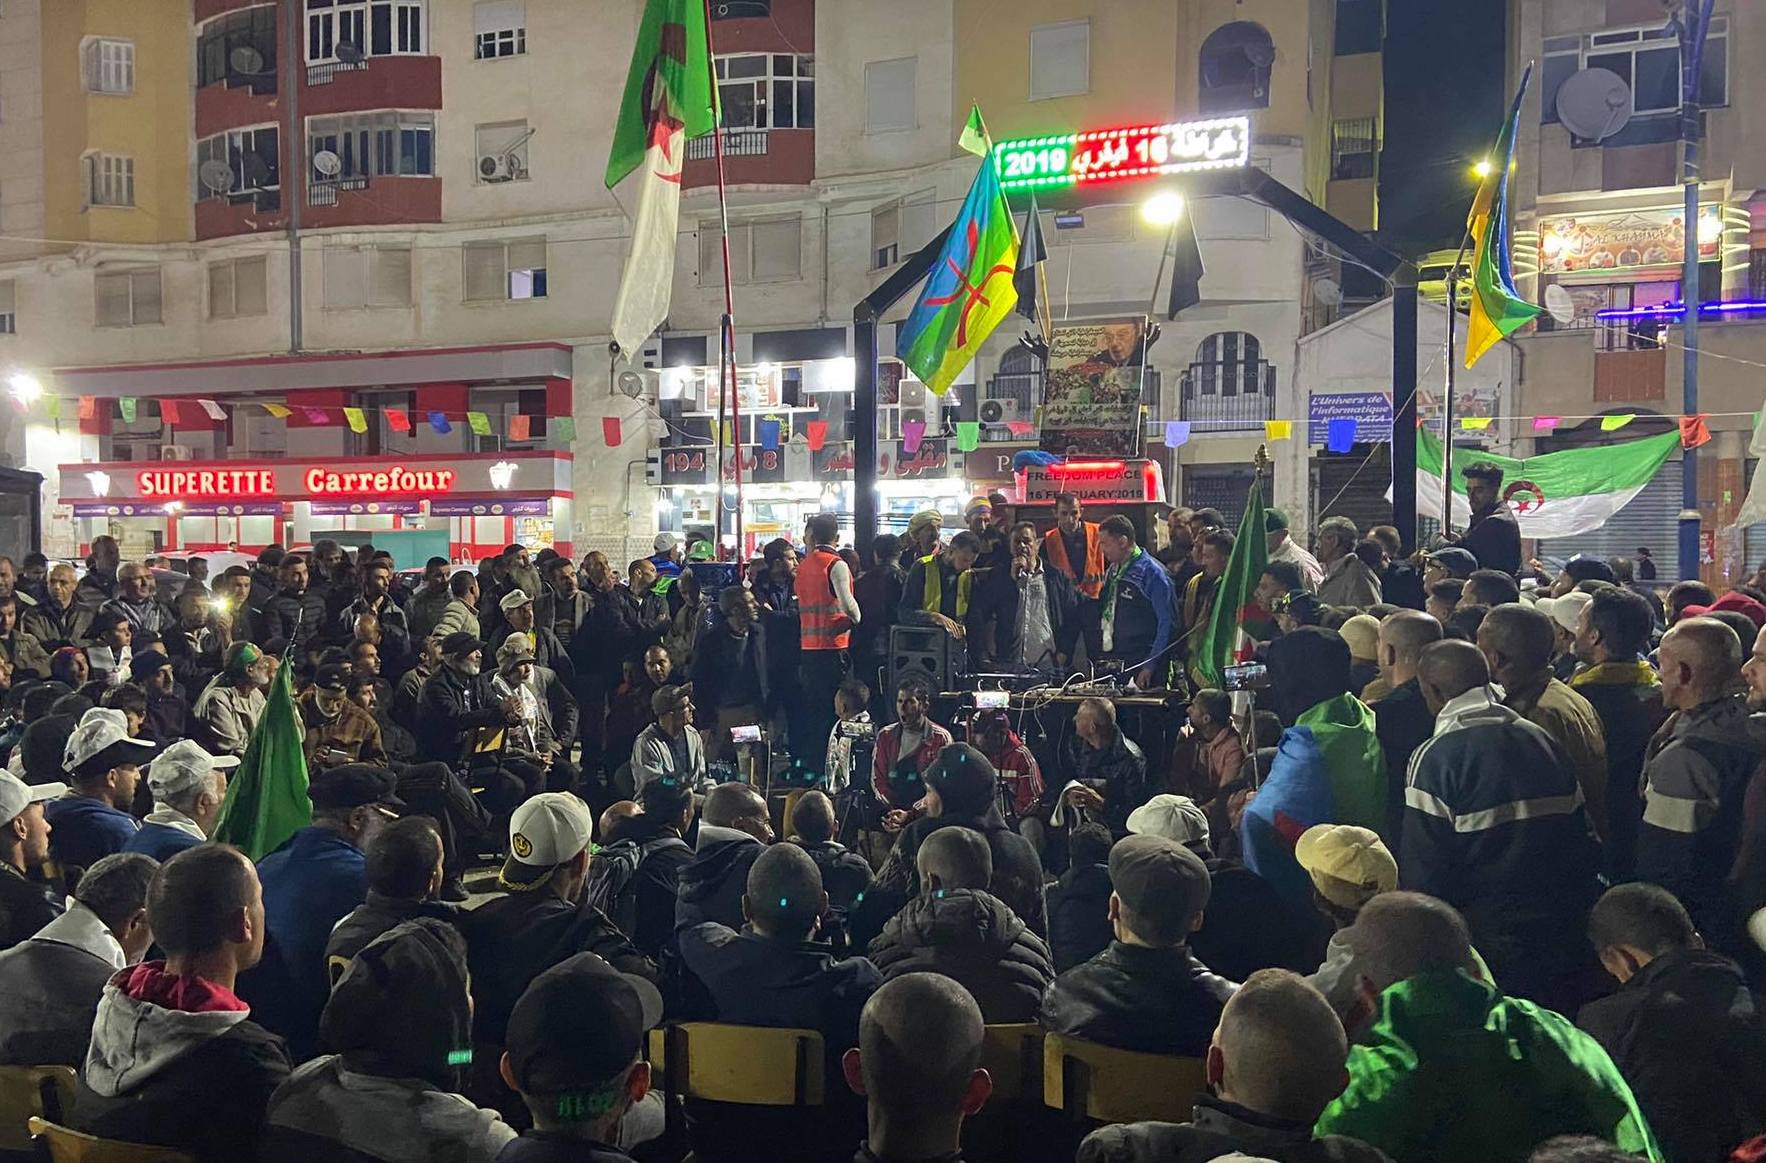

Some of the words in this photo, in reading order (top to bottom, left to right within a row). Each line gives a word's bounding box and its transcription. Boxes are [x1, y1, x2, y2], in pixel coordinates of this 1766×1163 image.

[1135, 135, 1168, 164] 16
[1005, 148, 1067, 176] 2019
[1311, 395, 1365, 405] L'Univers
[1367, 395, 1383, 404] de
[1311, 404, 1389, 415] l'informatique
[762, 450, 778, 471] 8
[140, 470, 274, 495] SUPERETTE
[306, 466, 452, 493] Carrefour
[1027, 470, 1093, 481] FREEDOM
[1096, 469, 1140, 480] PLACE
[1029, 490, 1043, 499] 16
